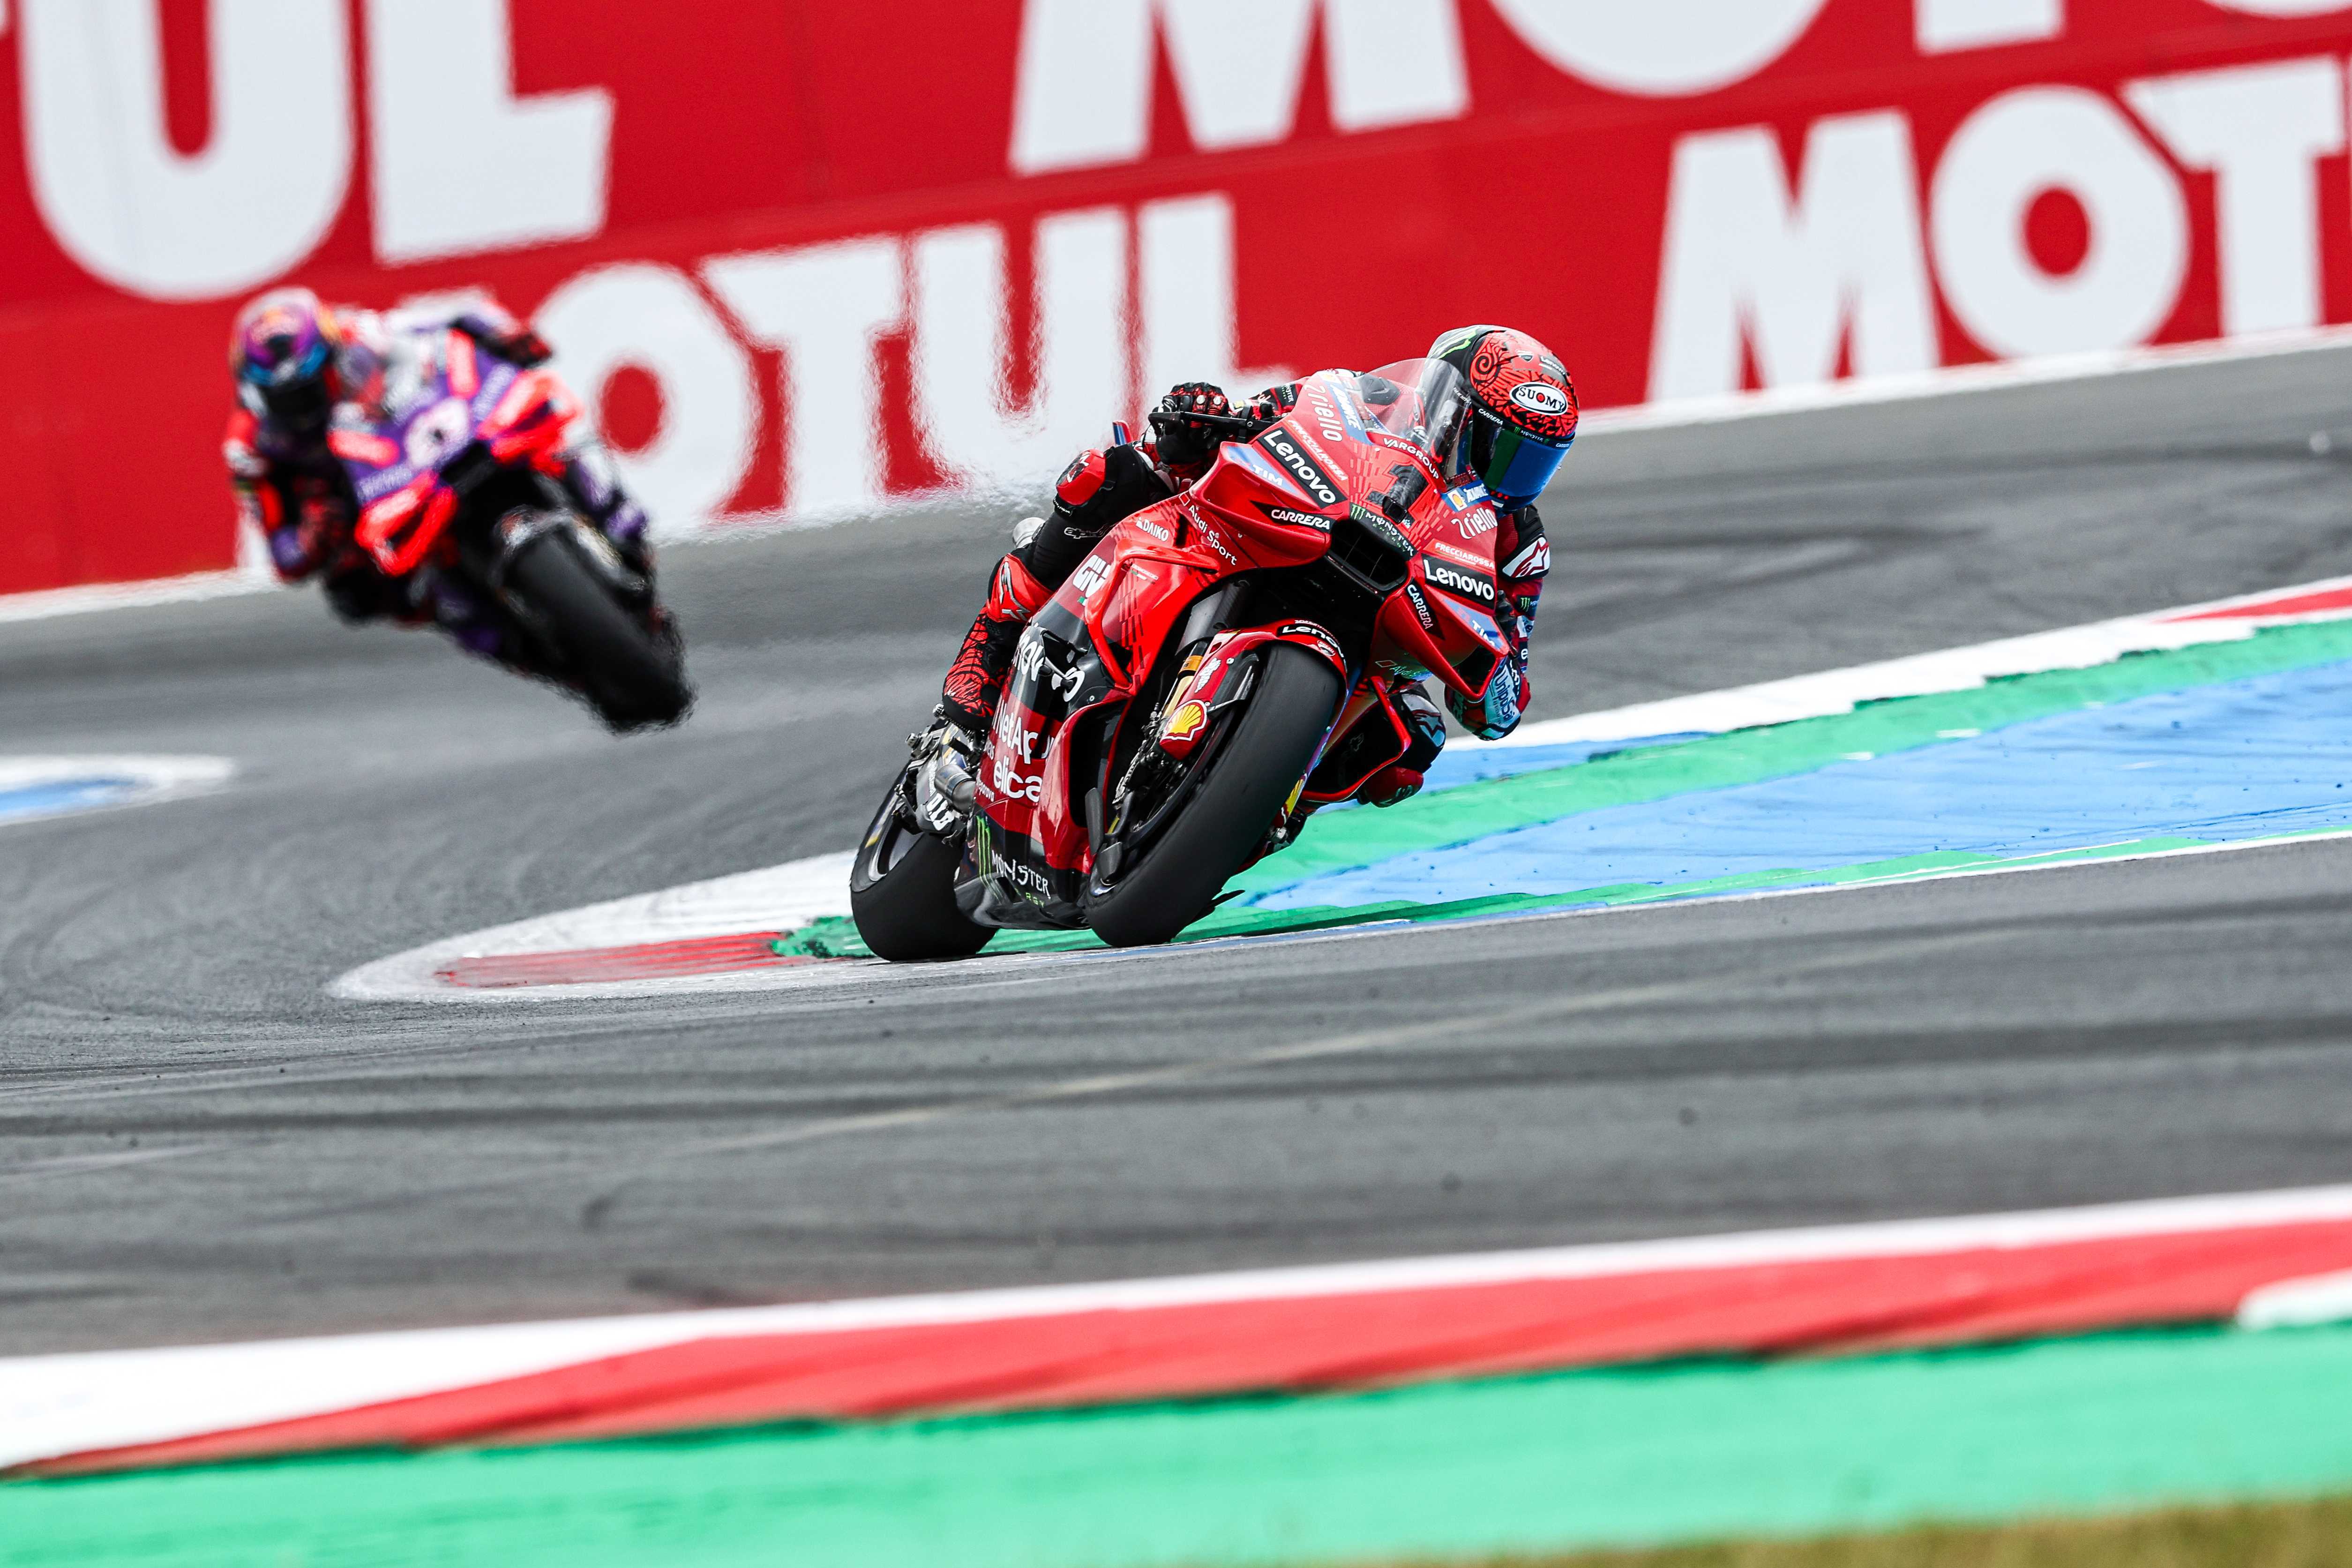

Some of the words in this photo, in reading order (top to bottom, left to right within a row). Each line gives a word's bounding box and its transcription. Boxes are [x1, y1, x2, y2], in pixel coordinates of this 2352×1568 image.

[0, 0, 613, 302] UL
[1643, 54, 2352, 404] MOT
[237, 195, 1295, 571] OTUL
[1519, 387, 1565, 412] SUOMY
[1478, 408, 1503, 425] CARRERA
[1252, 464, 1284, 486] TIM
[1263, 430, 1336, 504] Lenovo
[1383, 437, 1439, 479] VARGROUP
[1189, 504, 1208, 533] Audi
[1206, 530, 1237, 566] Sport
[1271, 509, 1331, 530] CARRERA
[1365, 512, 1414, 556] MONSTER
[1435, 542, 1495, 569] FRECCIAROSSA
[1423, 559, 1495, 600] Lenovo
[1407, 584, 1434, 630] CARRERA
[996, 699, 1055, 764] NetAp
[993, 755, 1043, 803] elica
[991, 849, 1051, 900] MONSTER
